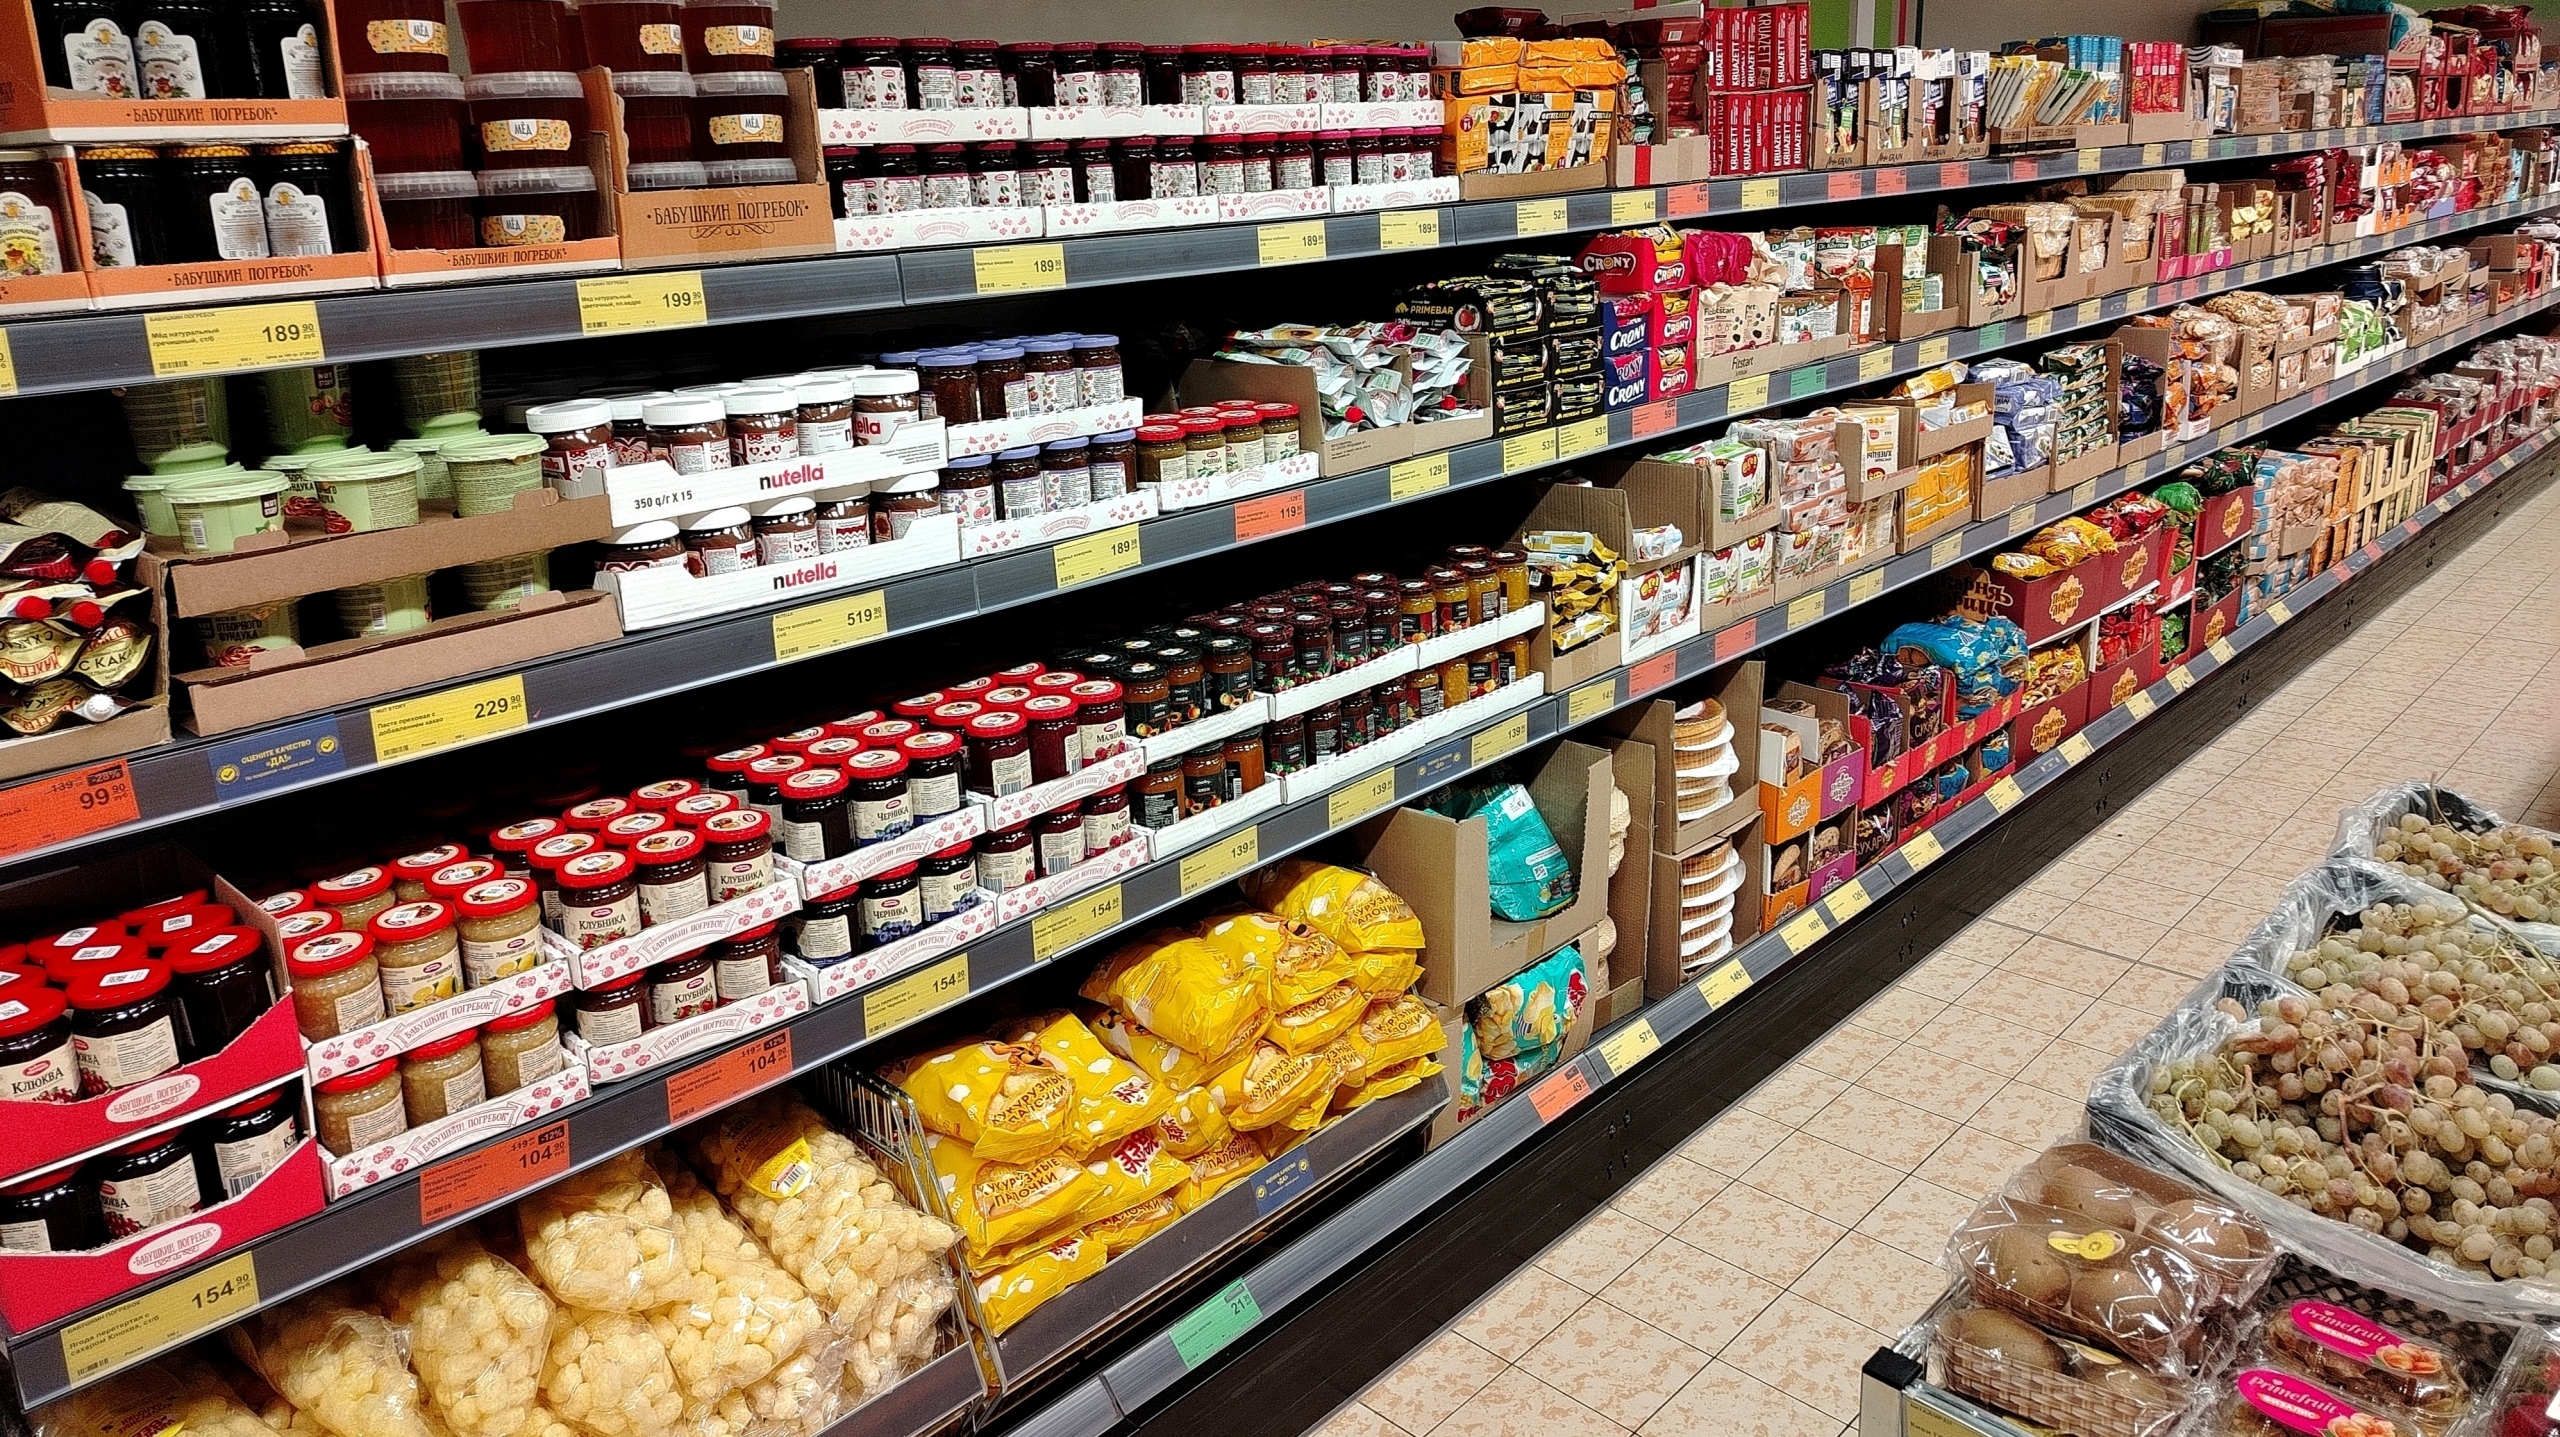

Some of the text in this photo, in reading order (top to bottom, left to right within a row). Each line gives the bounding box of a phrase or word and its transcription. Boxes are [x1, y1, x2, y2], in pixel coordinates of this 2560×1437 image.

[1758, 12, 1771, 64] KRUAZETT
[1715, 41, 1723, 87] KRUAZETT
[1732, 41, 1740, 86] KRUAZETT
[1747, 43, 1755, 87] KRUAZETT
[1777, 39, 1786, 83] KRUAZETT
[133, 106, 275, 123] БАБУШКИН ПОГРЕБОК
[1730, 126, 1738, 170] KRUAZETT
[1743, 127, 1751, 170] KRUAZETT
[1773, 124, 1781, 167] KRUAZETT
[1783, 123, 1791, 166] KRUAZETT
[1794, 123, 1802, 165] KRUAZETT
[655, 201, 803, 225] БАБУШКИН ПОГРЕБОК
[1418, 223, 1432, 234] 189
[1302, 235, 1318, 247] 189
[452, 248, 563, 267] БАБУШКИН ПОГРЕБОК
[1033, 260, 1054, 273] 189
[174, 265, 313, 286] БАБУШКИН ПОГРЕБОК
[662, 291, 691, 308] 199
[1410, 305, 1454, 315] PRIMEBAR
[262, 322, 314, 343] 189 90
[1610, 322, 1646, 352] CRONY
[1608, 378, 1646, 406] CRONY
[759, 464, 824, 491] nutella
[1429, 464, 1442, 477] 129
[634, 489, 693, 510] 350 15
[1279, 506, 1297, 520] 119
[1110, 539, 1127, 557] 189
[773, 561, 837, 590] nutella
[847, 608, 873, 626] 519
[474, 694, 522, 720] 229 90
[377, 719, 397, 731] Паста
[1507, 726, 1521, 740] 139
[240, 739, 313, 765] ОЦЕНИТЕ КАЧЕСТВО
[79, 782, 128, 810] 99 90
[1371, 782, 1387, 799] 139
[1230, 841, 1249, 860] 139
[719, 868, 765, 885] КЛУБНИКА
[1091, 901, 1113, 919] 154
[578, 913, 627, 931] КЛУБНИКА
[932, 973, 957, 995] 154
[404, 1001, 492, 1041] БАБУШКИН ПОГРЕБОК
[748, 1051, 778, 1074] 104
[11, 1066, 65, 1095] КЛЮКВА
[422, 1111, 508, 1153] БАБУШКИН ПОГРЕБОК
[519, 1145, 553, 1169] 104
[135, 1231, 213, 1267] БАБУШКИН ПОГРЕБОК
[191, 1273, 250, 1310] 154 90
[1230, 1297, 1245, 1315] 21
[68, 1337, 95, 1352] Ягода
[71, 1336, 107, 1356] сахаром
